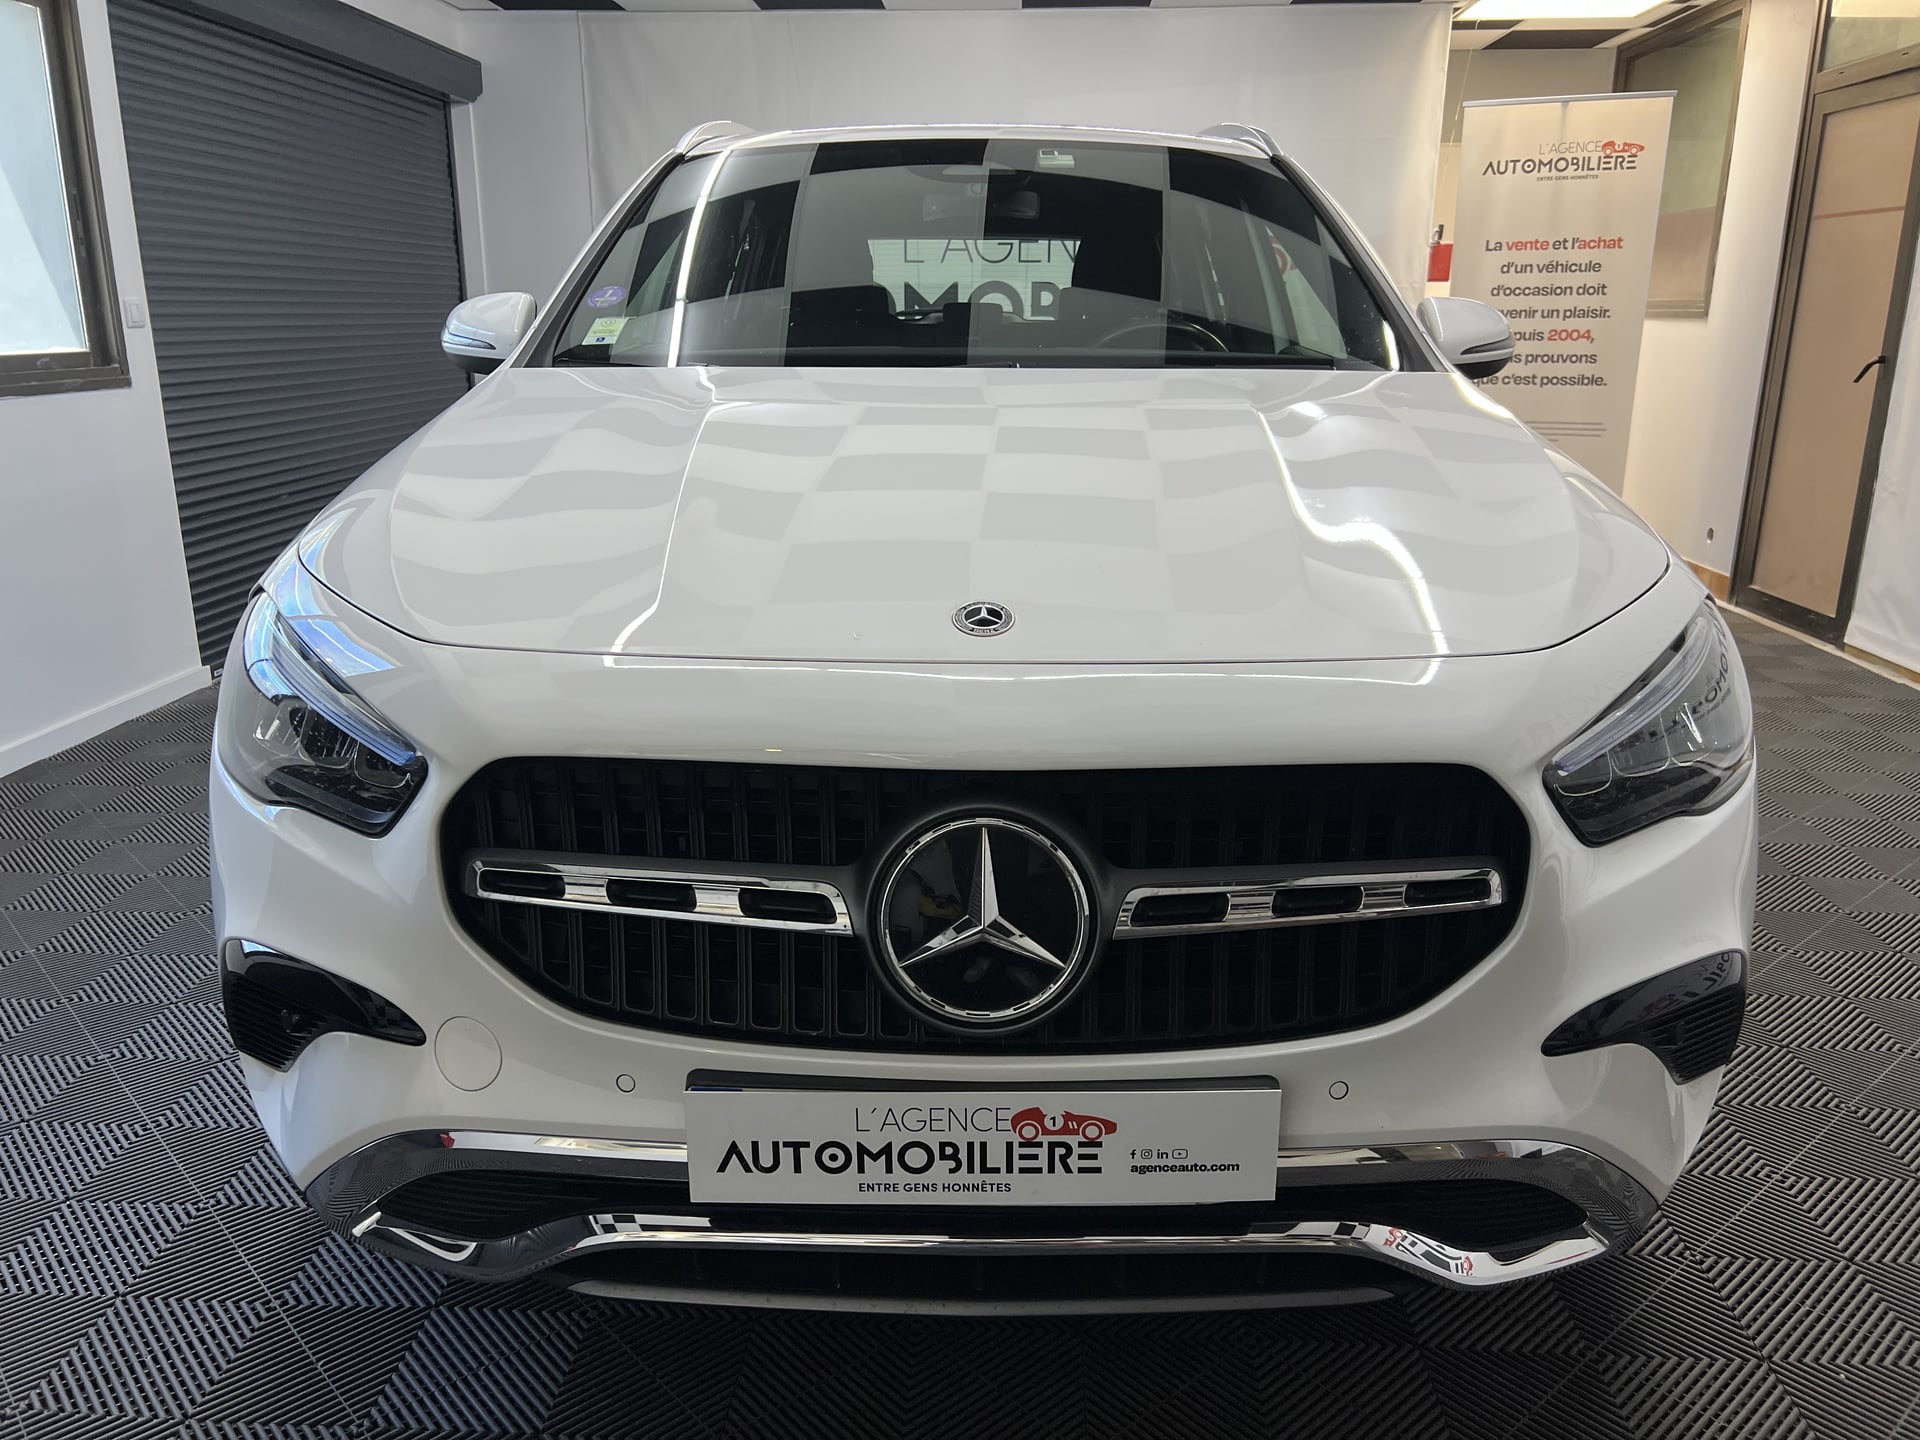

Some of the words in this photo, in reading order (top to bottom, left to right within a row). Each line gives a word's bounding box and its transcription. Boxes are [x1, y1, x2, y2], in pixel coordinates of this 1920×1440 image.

[1539, 141, 1603, 155] L'AGENCE
[1485, 239, 1503, 252] La
[1506, 239, 1549, 251] vente
[1552, 238, 1568, 250] et
[1571, 236, 1623, 250] l'achat
[1500, 261, 1533, 274] d'un
[1536, 260, 1602, 274] véhicule
[1490, 284, 1573, 297] d'occasion
[1576, 283, 1608, 296] doit
[1499, 306, 1538, 319] venir
[1541, 309, 1560, 319] un
[1563, 306, 1611, 321] plaisir.
[1514, 329, 1545, 341] puis
[1547, 329, 1595, 344] 2004,
[1525, 353, 1598, 366] prouvons
[1502, 374, 1538, 386] c'est
[1540, 374, 1607, 388] possible.
[855, 1107, 1012, 1132] L'AGENCE
[1130, 1162, 1240, 1175] agenceauto.com
[858, 1182, 900, 1193] ENTRE
[903, 1182, 938, 1193] GENS
[942, 1179, 1012, 1193] HONNÊTES
